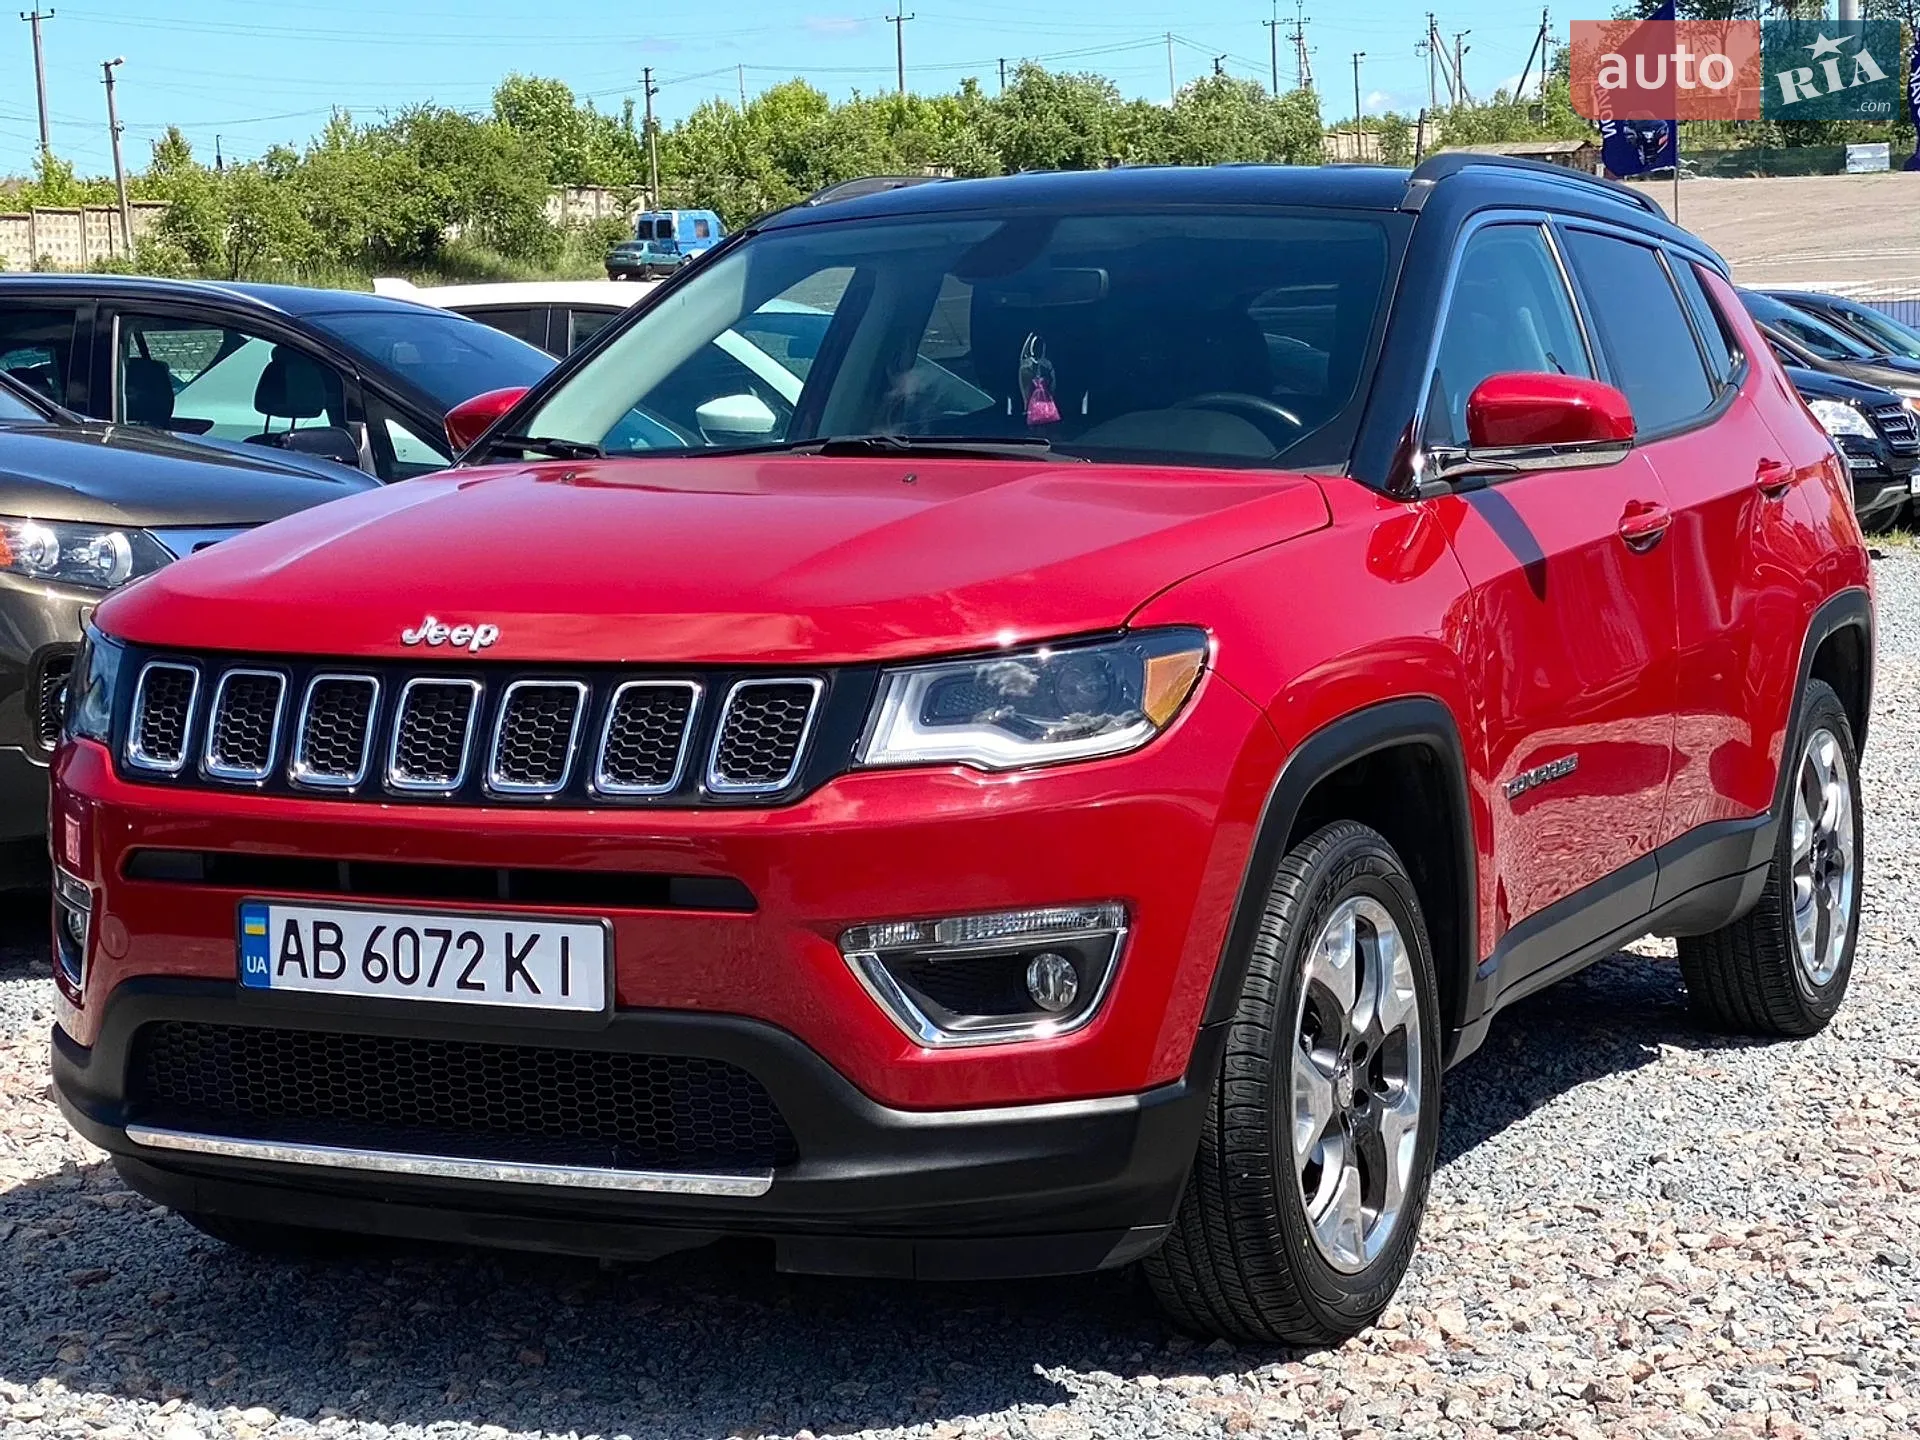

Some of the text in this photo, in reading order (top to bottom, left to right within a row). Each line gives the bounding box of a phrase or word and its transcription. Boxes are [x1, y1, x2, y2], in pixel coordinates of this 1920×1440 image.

[402, 615, 499, 652] Jeep
[246, 956, 268, 974] UA
[277, 919, 570, 997] AB 6072 KI
